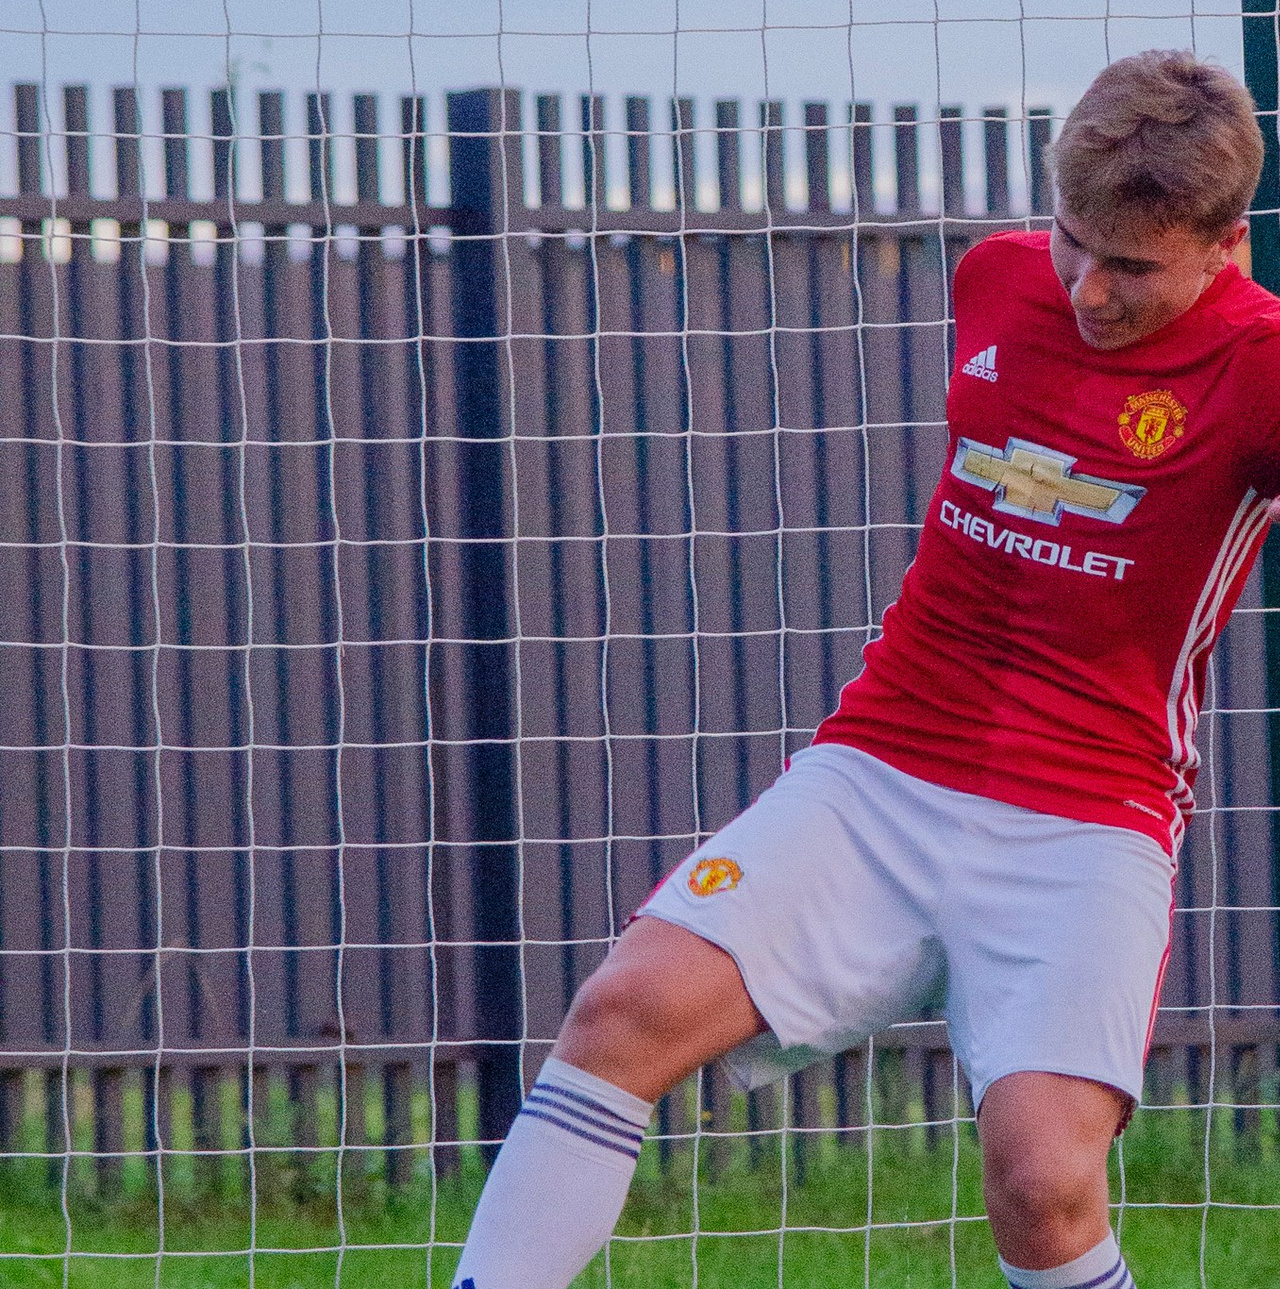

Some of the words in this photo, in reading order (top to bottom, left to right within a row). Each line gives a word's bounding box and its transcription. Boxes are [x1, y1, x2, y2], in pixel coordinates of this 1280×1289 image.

[962, 363, 999, 383] adidas
[1127, 437, 1165, 455] UNITED
[940, 499, 1135, 580] CHEVROLET
